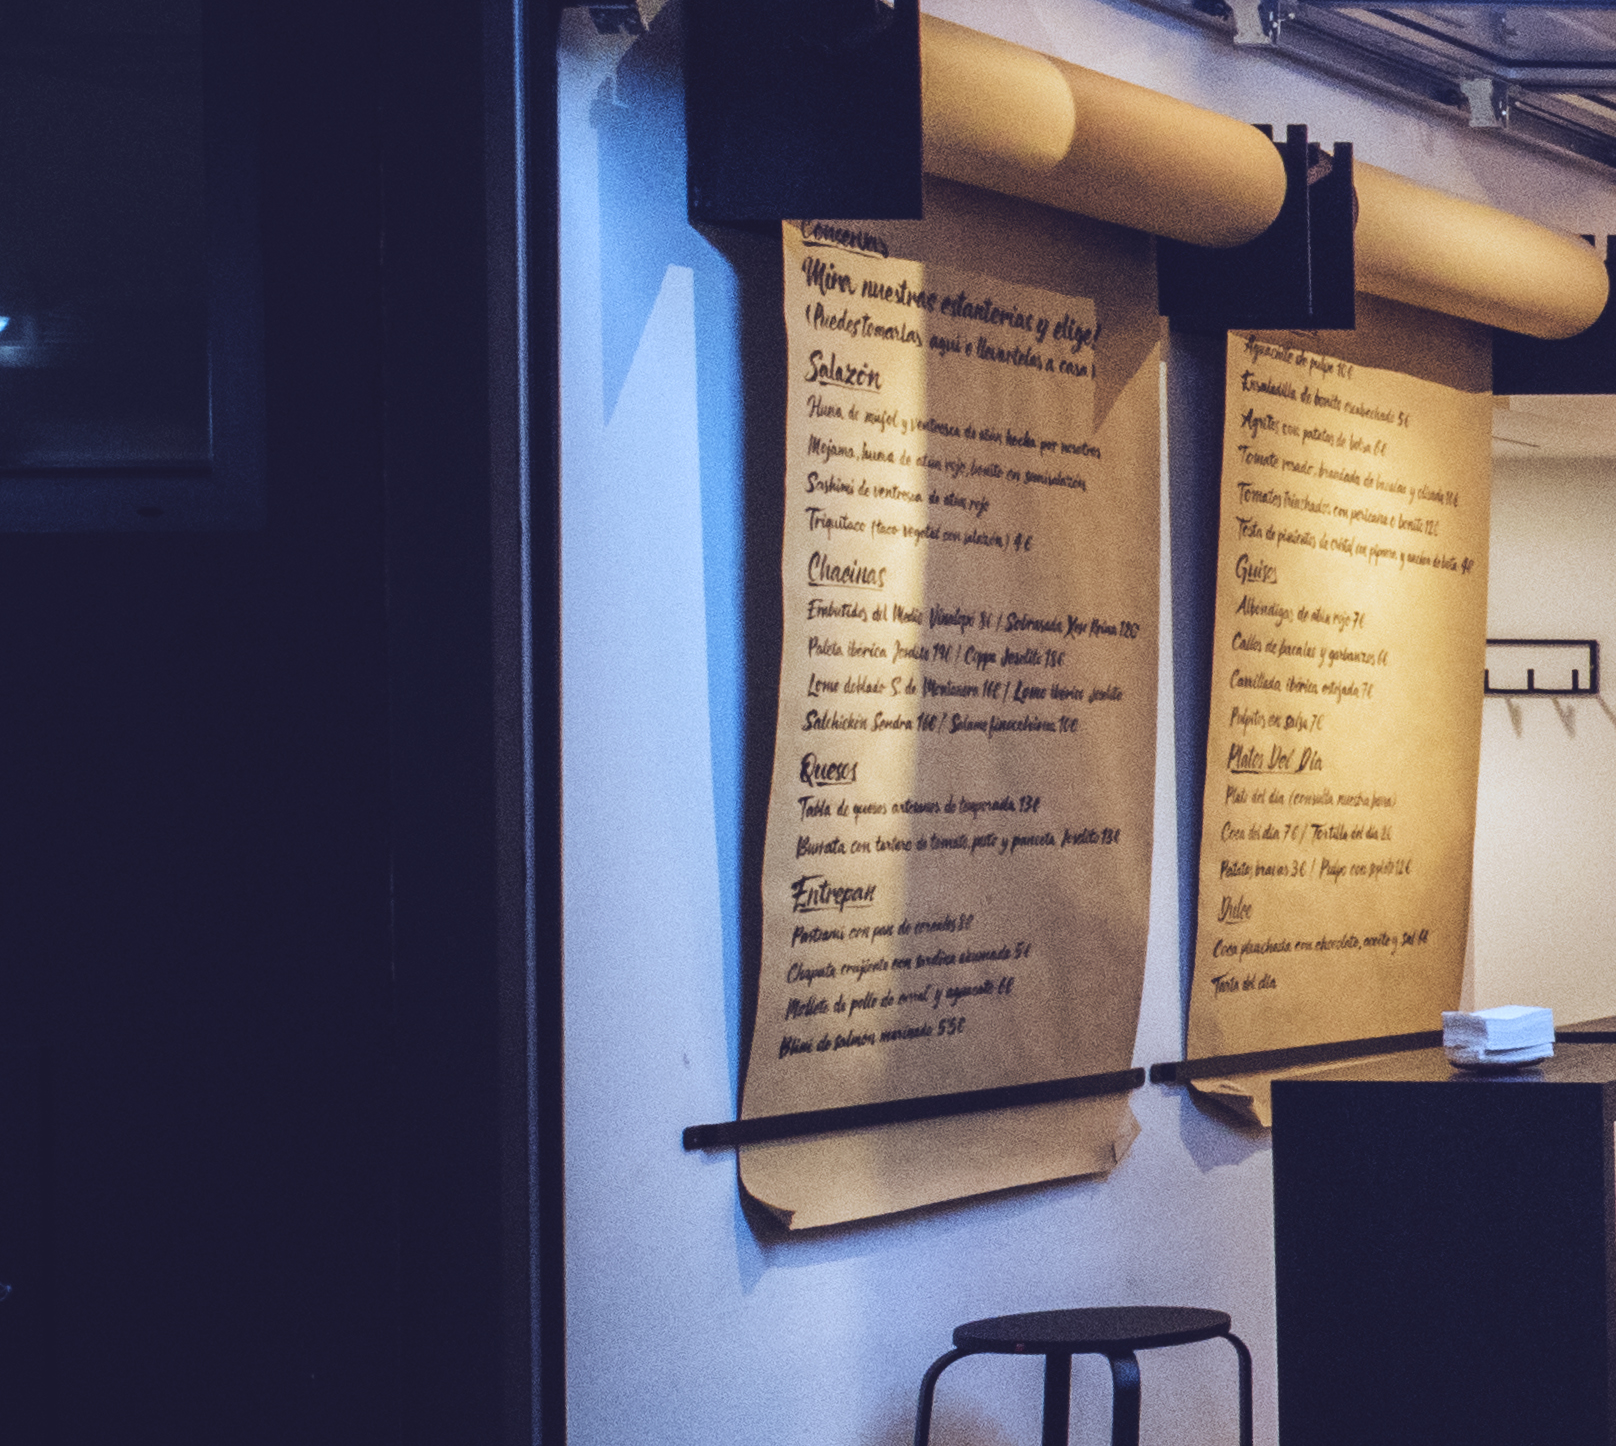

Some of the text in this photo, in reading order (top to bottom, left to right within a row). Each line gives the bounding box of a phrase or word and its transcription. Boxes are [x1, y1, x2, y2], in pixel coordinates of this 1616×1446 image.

[802, 256, 856, 296] Mira
[862, 280, 937, 313] nuestras
[1036, 318, 1049, 343] y
[804, 350, 882, 390] Salazón
[1300, 385, 1312, 405] de
[848, 404, 859, 421] de
[901, 418, 908, 435] y
[1336, 432, 1347, 448] de
[900, 449, 912, 466] de
[1005, 468, 1020, 482] en
[1237, 444, 1280, 469] Tomate
[806, 471, 854, 496] Sashimi
[858, 479, 870, 497] de
[928, 489, 940, 505] de
[1237, 480, 1282, 508] Tomates
[1333, 505, 1349, 519] con
[1265, 523, 1276, 541] de
[808, 551, 887, 588] Chacinas
[807, 598, 868, 622] Embutidos
[872, 603, 888, 622] del
[1297, 605, 1309, 622] de
[808, 636, 844, 658] Paleta
[1265, 639, 1278, 654] de
[1317, 647, 1327, 669] y
[1328, 647, 1376, 668] garbanzos
[807, 672, 840, 697] Lomo
[905, 677, 917, 695] de
[1013, 679, 1047, 704] Lomo
[1268, 713, 1282, 728] en
[799, 752, 859, 788] Quesos
[1251, 787, 1267, 805] del
[797, 795, 831, 822] Tabla
[836, 798, 849, 817] de
[852, 801, 888, 825] quesos
[943, 795, 957, 814] de
[1248, 822, 1261, 841] del
[1310, 823, 1348, 845] Tortilla
[1350, 823, 1365, 841] del
[796, 835, 847, 859] Burrata
[850, 839, 872, 854] con
[916, 837, 928, 852] de
[1000, 836, 1010, 855] y
[1255, 860, 1290, 877] bravas
[1290, 859, 1307, 878] 3€
[1319, 857, 1347, 884] Pulpo
[1350, 862, 1366, 877] con
[791, 874, 877, 913] Entrepan
[791, 925, 845, 948] Pastrami
[848, 926, 870, 940] con
[870, 924, 895, 945] pan
[897, 917, 911, 936] de
[1293, 939, 1312, 951] con
[786, 962, 837, 988] Chapata
[1241, 972, 1256, 992] del
[833, 993, 846, 1014] de
[848, 991, 879, 1018] pollo
[880, 988, 895, 1008] de
[816, 1032, 832, 1052] de
